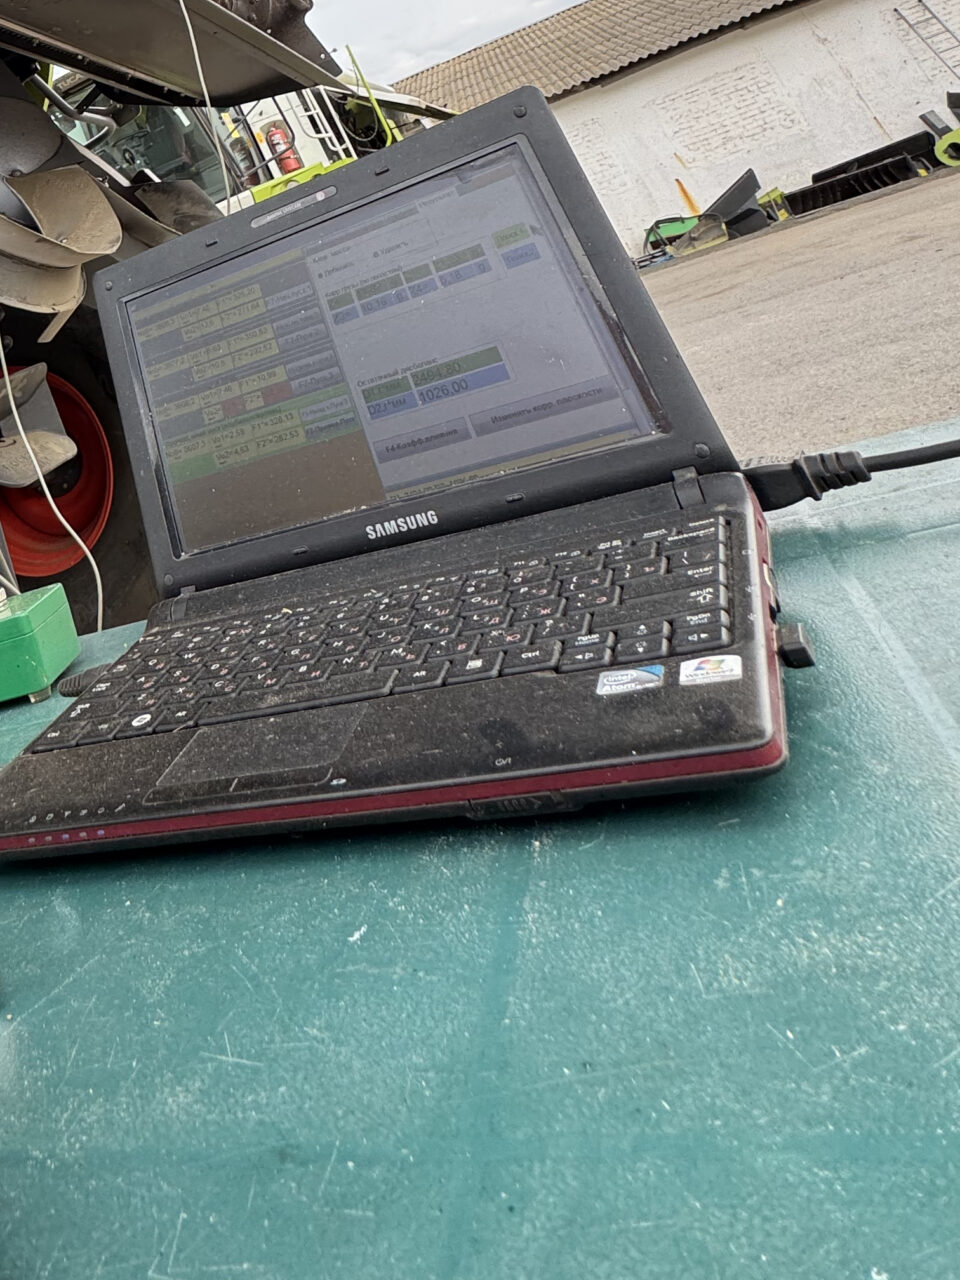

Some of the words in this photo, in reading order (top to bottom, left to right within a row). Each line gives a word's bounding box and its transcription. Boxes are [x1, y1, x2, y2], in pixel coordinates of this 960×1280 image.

[364, 510, 439, 541] SAMSUNG
[687, 565, 714, 577] Enter
[602, 682, 636, 692] Atom
